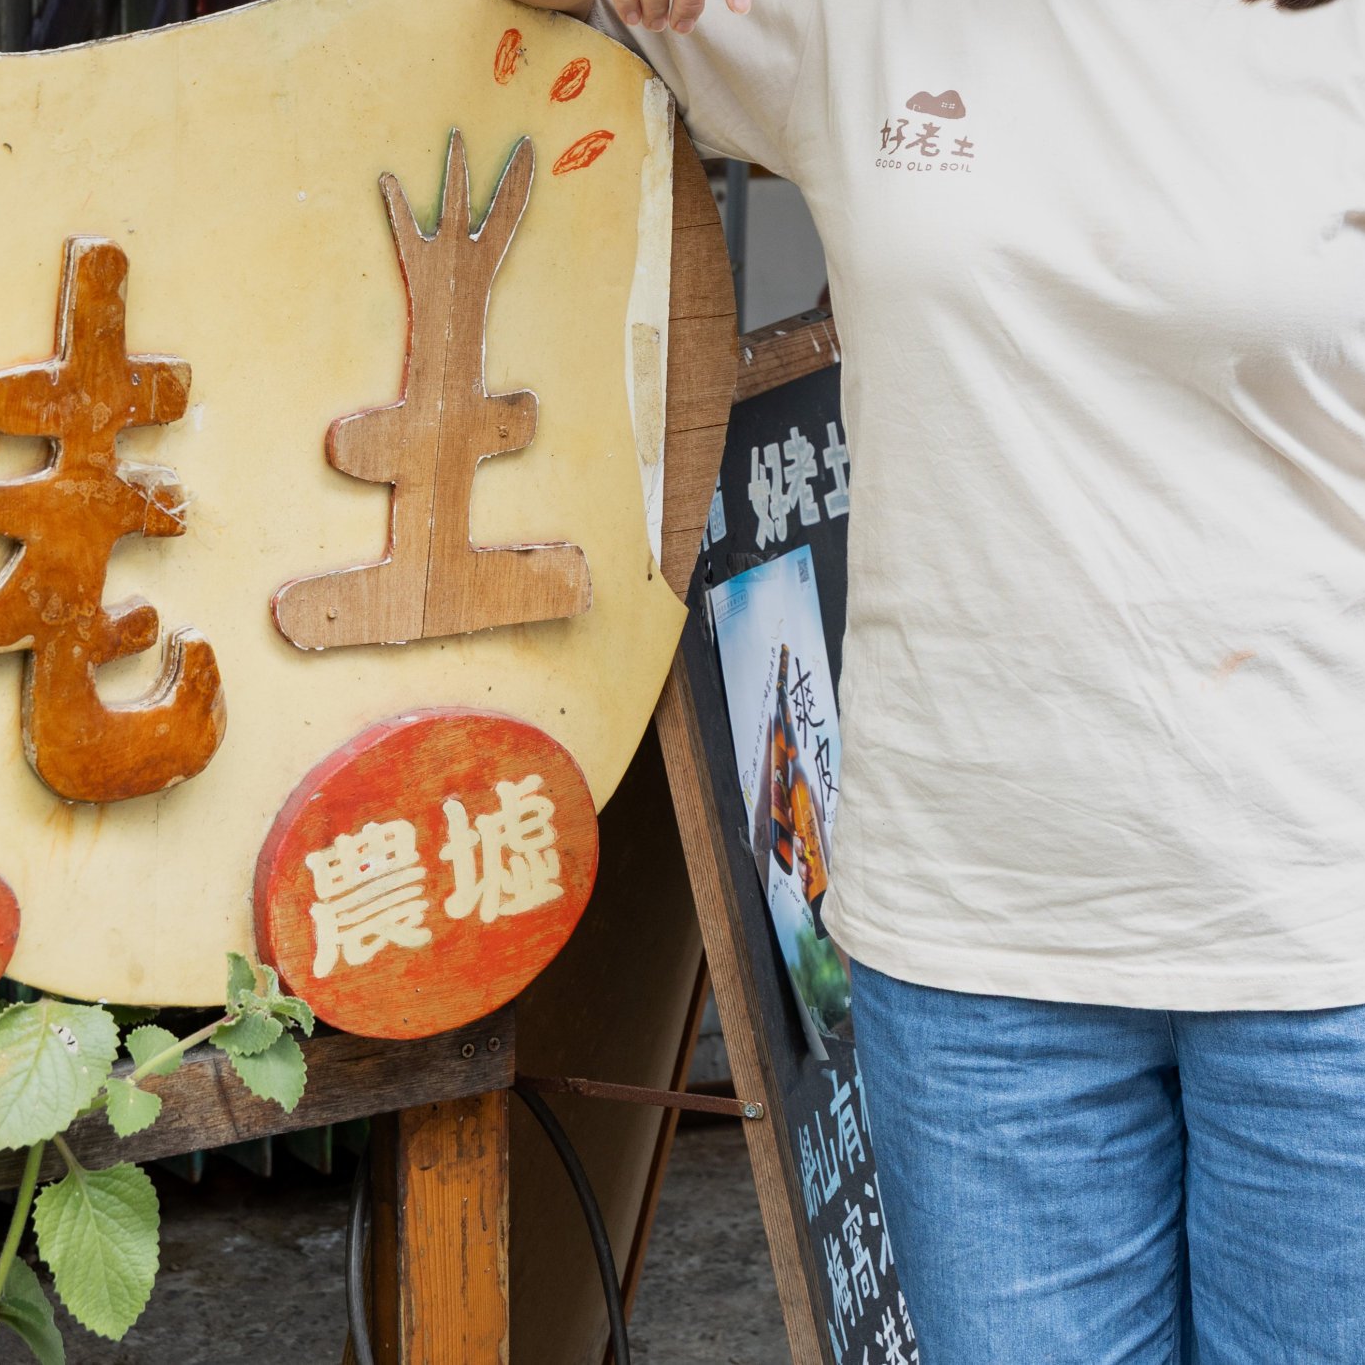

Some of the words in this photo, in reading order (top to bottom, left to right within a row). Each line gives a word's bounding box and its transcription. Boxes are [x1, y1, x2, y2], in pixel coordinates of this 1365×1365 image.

[875, 158, 902, 170] GOOD
[907, 161, 932, 172] OLD
[939, 162, 972, 173] SOIL
[878, 117, 975, 159] 好老土
[747, 420, 851, 551] 好老土
[304, 774, 566, 978] 農墟
